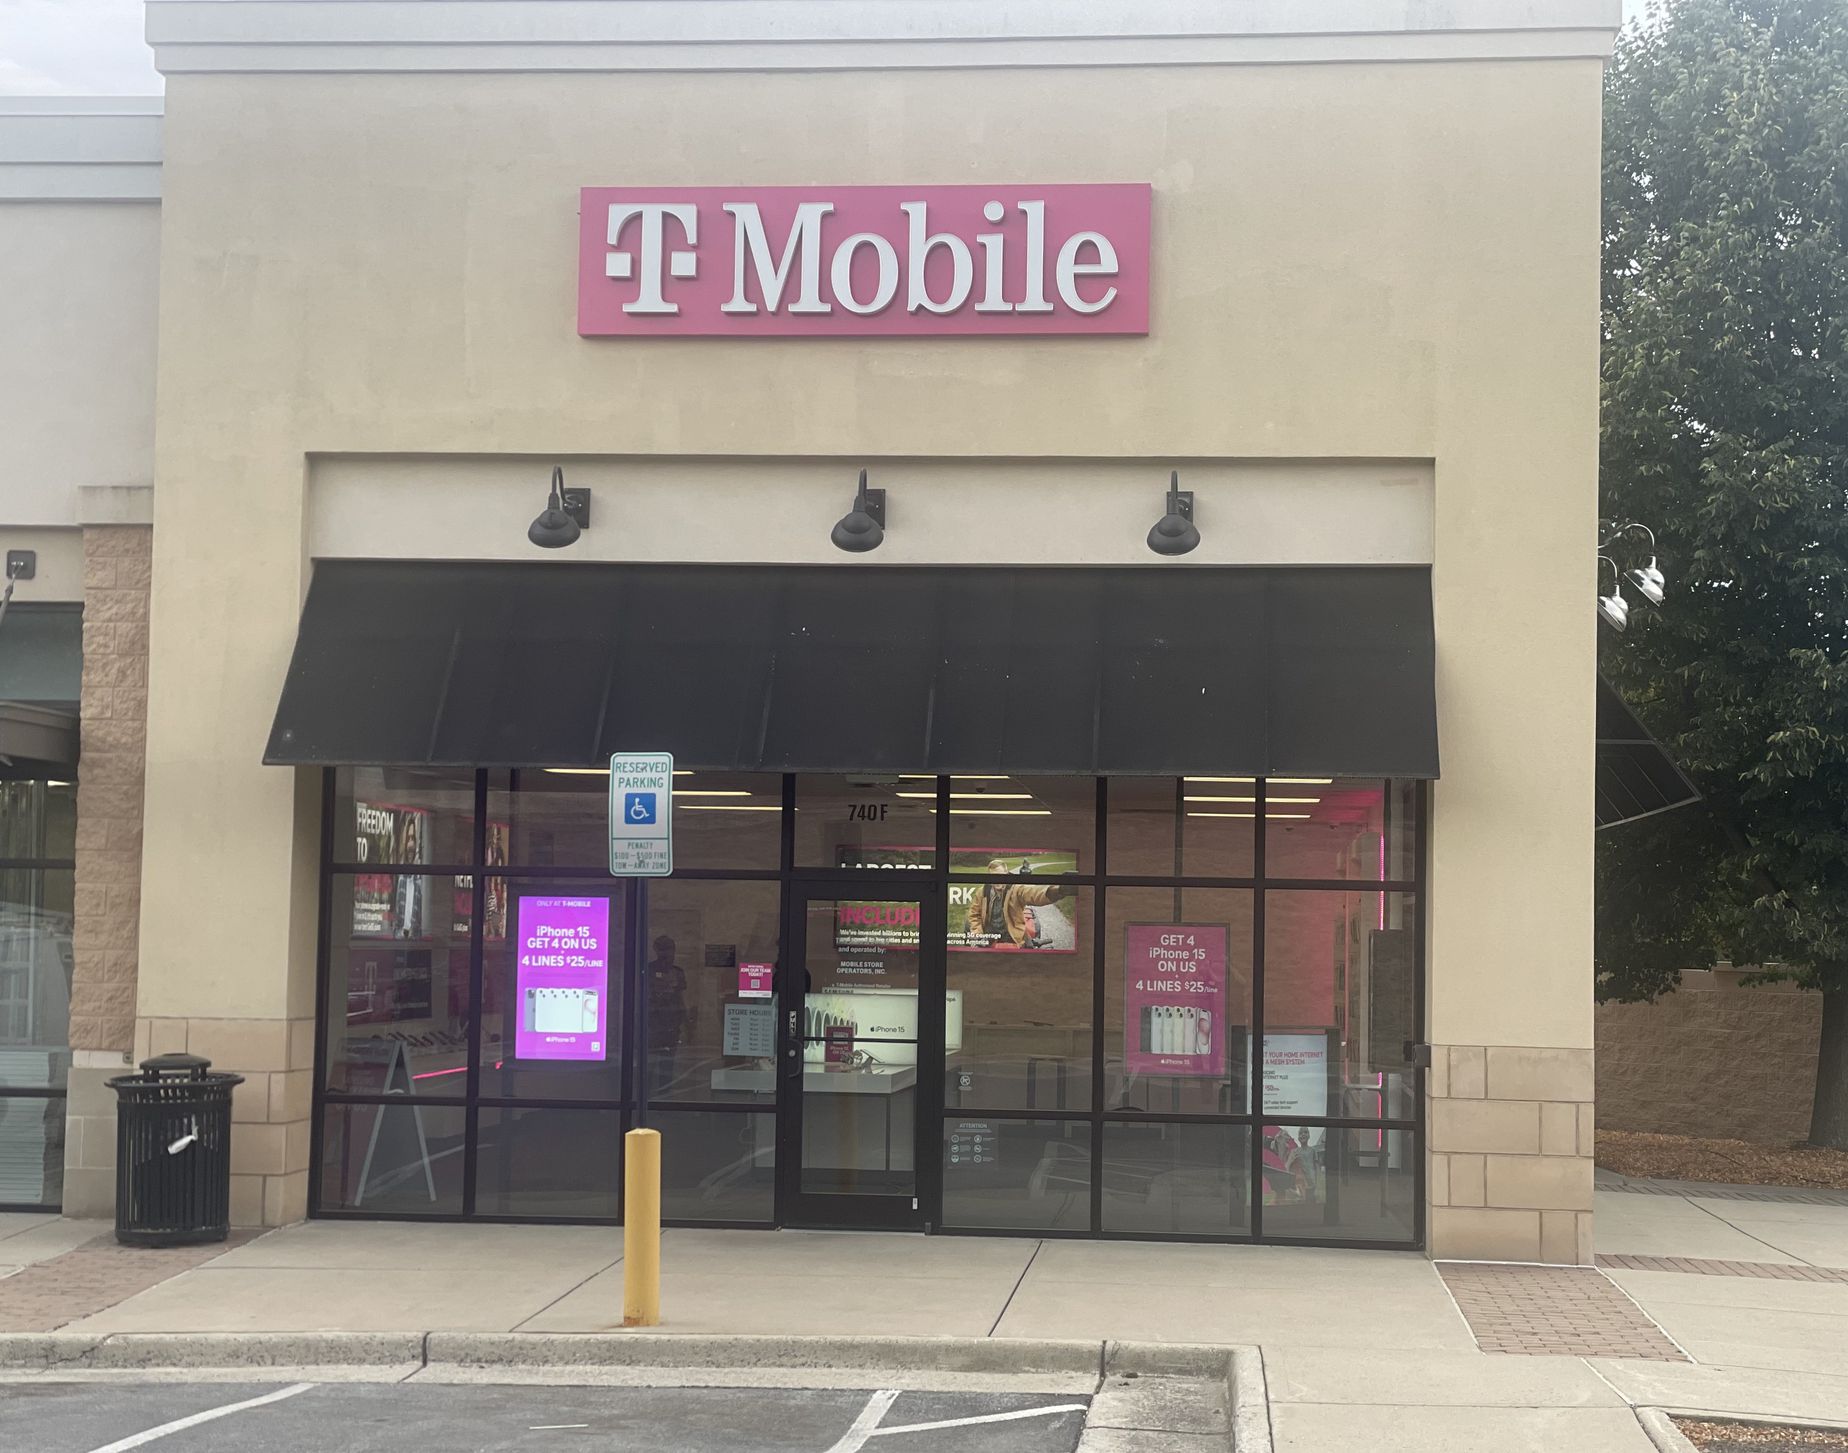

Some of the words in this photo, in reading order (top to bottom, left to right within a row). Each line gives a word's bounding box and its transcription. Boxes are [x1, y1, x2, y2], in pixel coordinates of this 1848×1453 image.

[721, 200, 1119, 316] Mobile
[615, 762, 668, 773] RESERVED
[618, 777, 664, 788] PARKING
[356, 806, 394, 834] FREEDOM
[356, 837, 368, 862] TO
[627, 841, 654, 850] PENALTY
[562, 900, 591, 908] T-MOBILE
[536, 925, 575, 938] iPhone
[576, 926, 591, 938] 15
[975, 932, 1002, 940] coverage
[527, 937, 550, 949] GET
[551, 938, 560, 949] 4
[561, 938, 579, 949] ON
[581, 938, 598, 950] US
[1160, 934, 1185, 946] GET
[1186, 935, 1195, 946] 4
[850, 946, 876, 954] operated
[1149, 946, 1190, 959] iPhone
[1192, 948, 1206, 960] 15
[521, 955, 530, 967] 4
[531, 955, 565, 967] LINES
[1158, 960, 1177, 972] ON
[1179, 961, 1197, 973] US
[836, 967, 874, 975] OPERATORS,
[1136, 979, 1144, 991] 4
[1147, 980, 1182, 992] LINES
[727, 1008, 748, 1016] STORE
